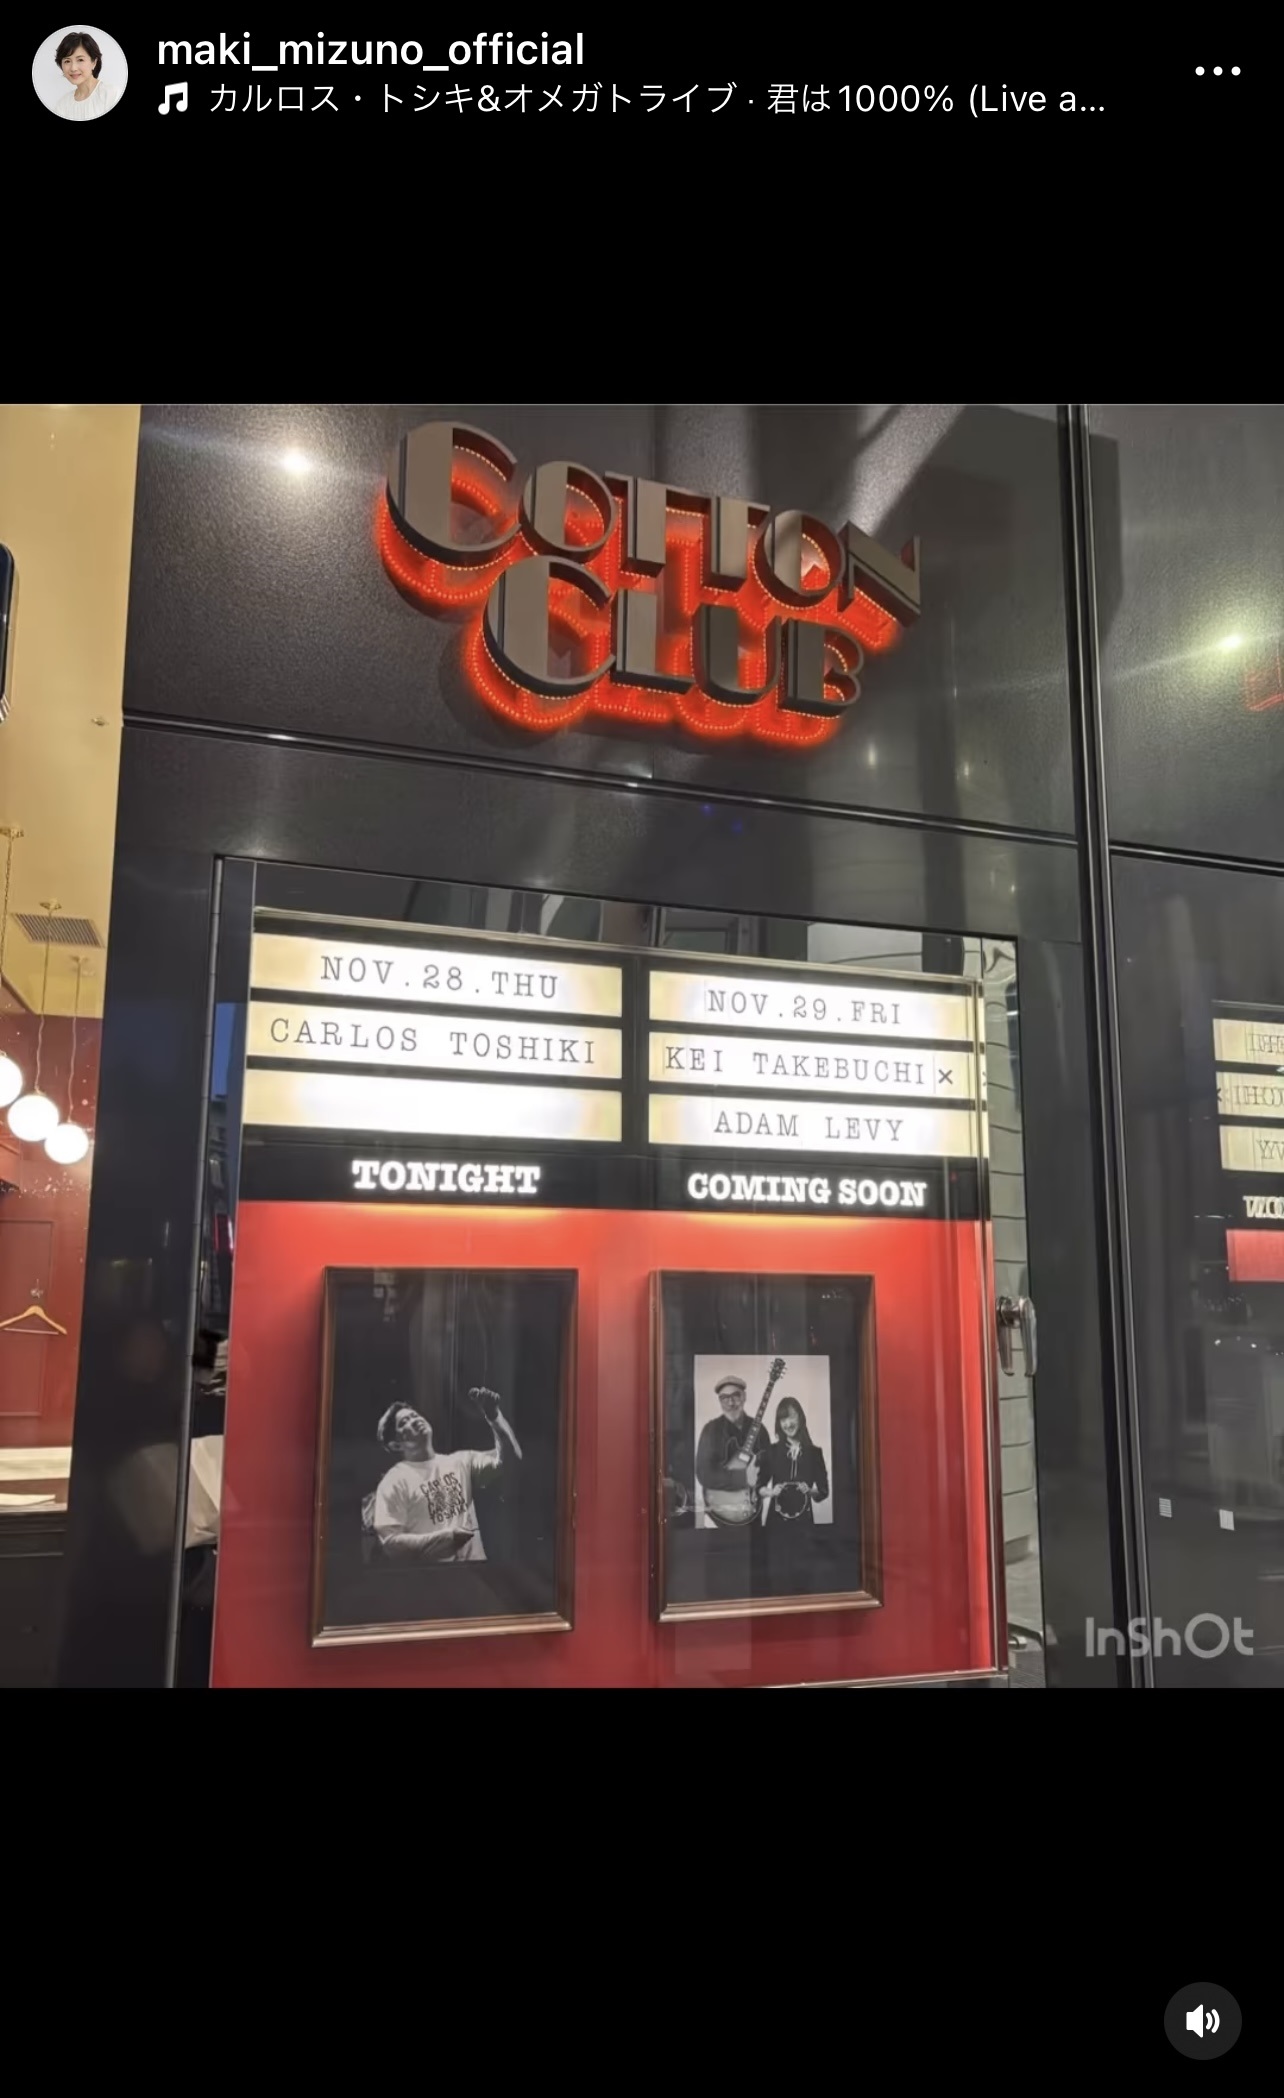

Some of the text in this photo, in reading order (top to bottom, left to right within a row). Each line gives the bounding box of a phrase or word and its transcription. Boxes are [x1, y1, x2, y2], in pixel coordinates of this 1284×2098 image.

[386, 420, 921, 627] COTTON
[482, 554, 864, 718] CLUB
[319, 955, 559, 999] NOV.28.THU
[706, 988, 902, 1026] NOV.29.FRI
[269, 1017, 596, 1065] CARLOS TOSHIKI
[664, 1045, 725, 1074] KEI
[752, 1051, 926, 1086] TAKEBUCHI
[713, 1110, 904, 1142] ADAM LEVY
[351, 1159, 541, 1195] TONIGHT
[687, 1171, 928, 1208] COMING SOON
